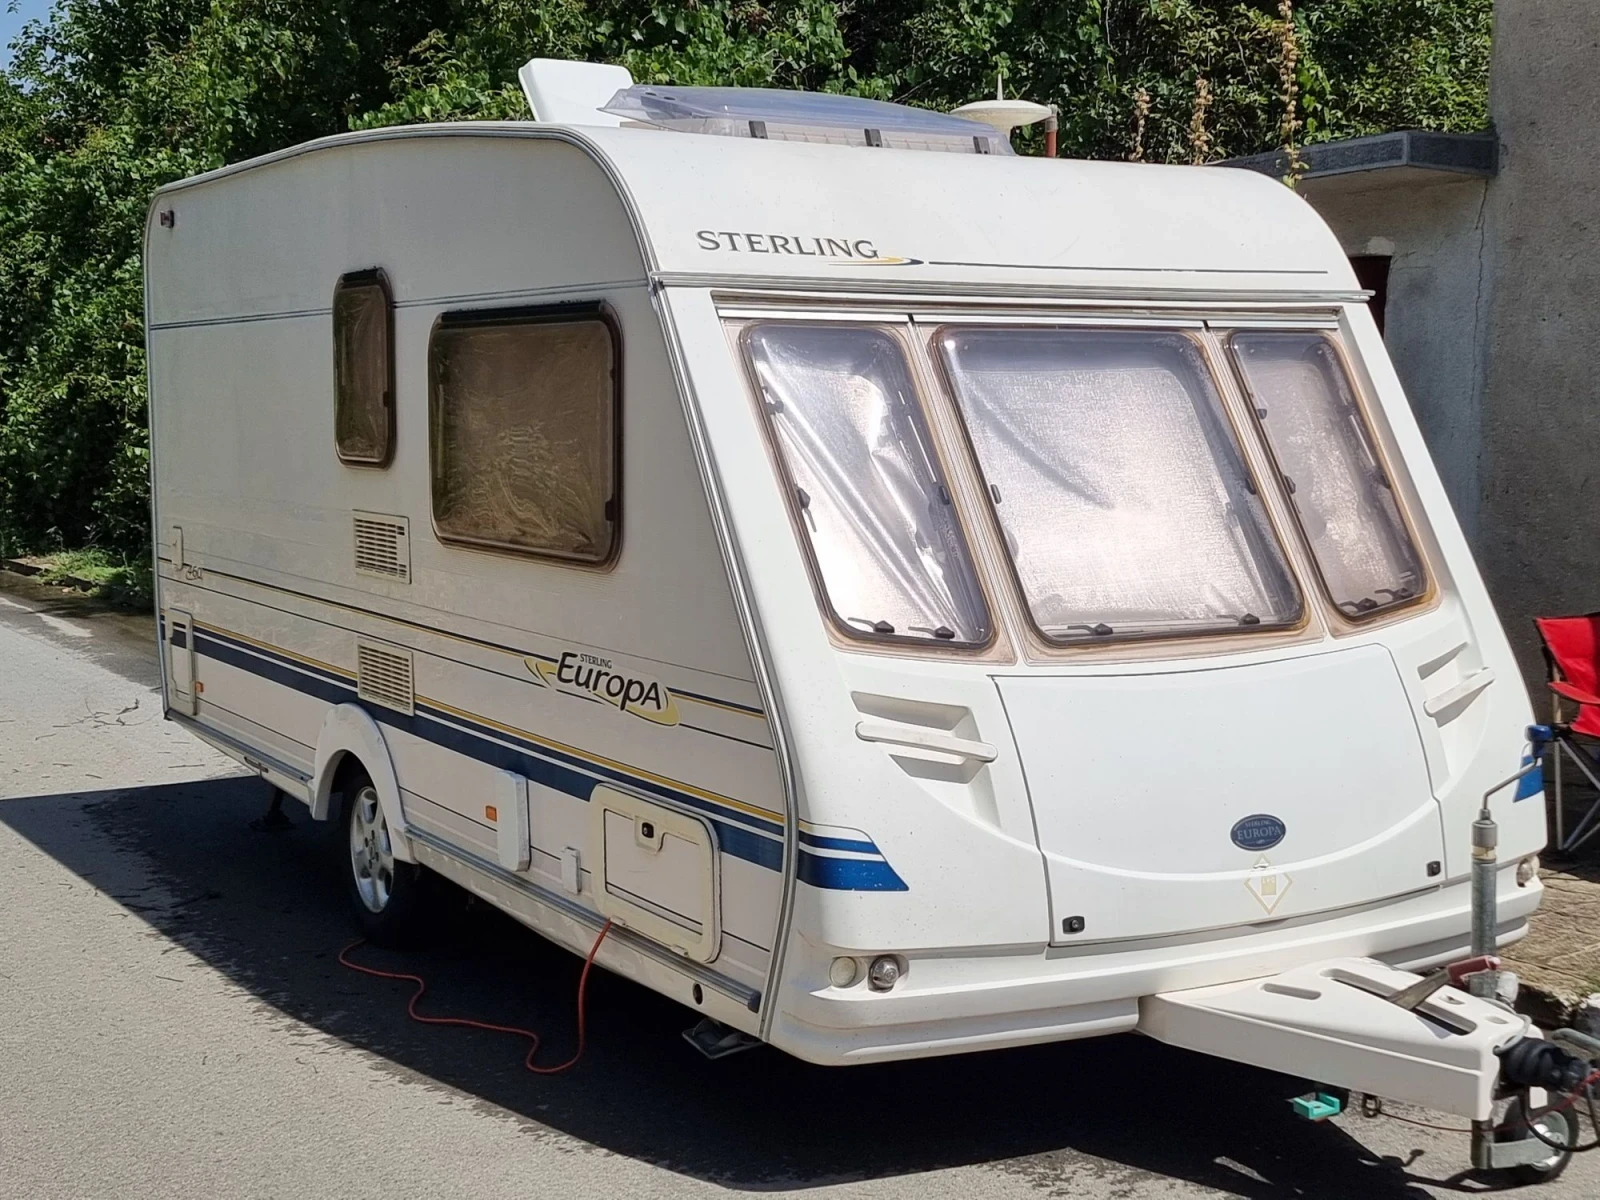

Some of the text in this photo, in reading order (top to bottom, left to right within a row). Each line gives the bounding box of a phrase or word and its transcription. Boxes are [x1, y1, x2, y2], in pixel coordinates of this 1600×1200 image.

[696, 230, 880, 259] STERLING
[579, 653, 612, 669] STERLING
[1237, 826, 1281, 841] EUROPA
